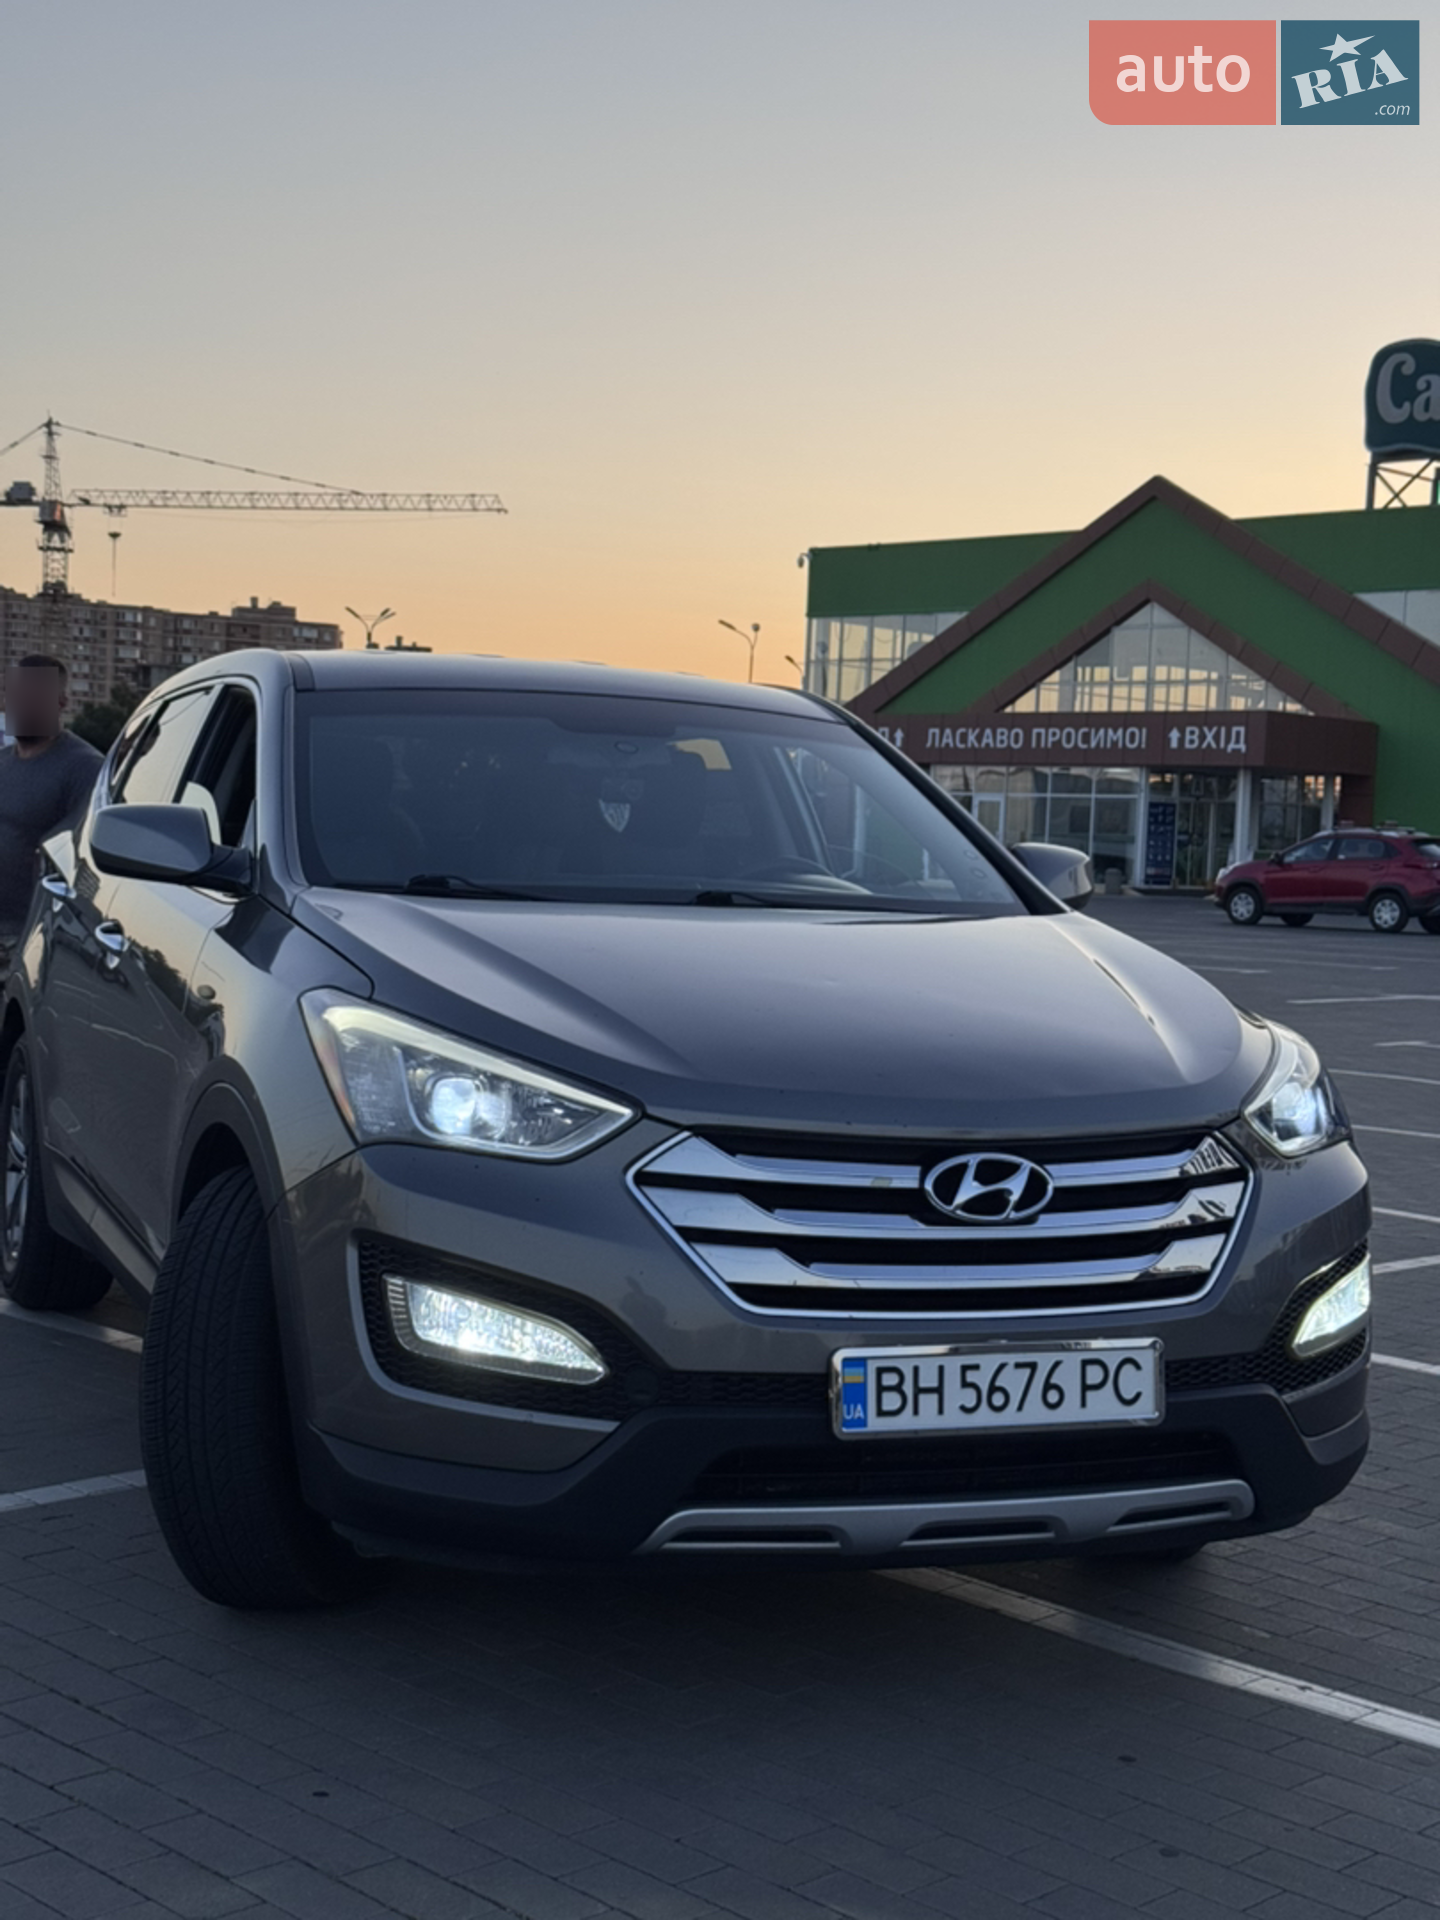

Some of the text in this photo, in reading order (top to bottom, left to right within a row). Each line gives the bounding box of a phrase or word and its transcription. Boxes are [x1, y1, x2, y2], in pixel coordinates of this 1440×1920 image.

[926, 727, 1147, 749] ЛАСКАВО ПРОСИМО!
[1184, 726, 1246, 753] ВХІД
[875, 1356, 1143, 1418] BH 5676 PC
[843, 1403, 864, 1420] UA
